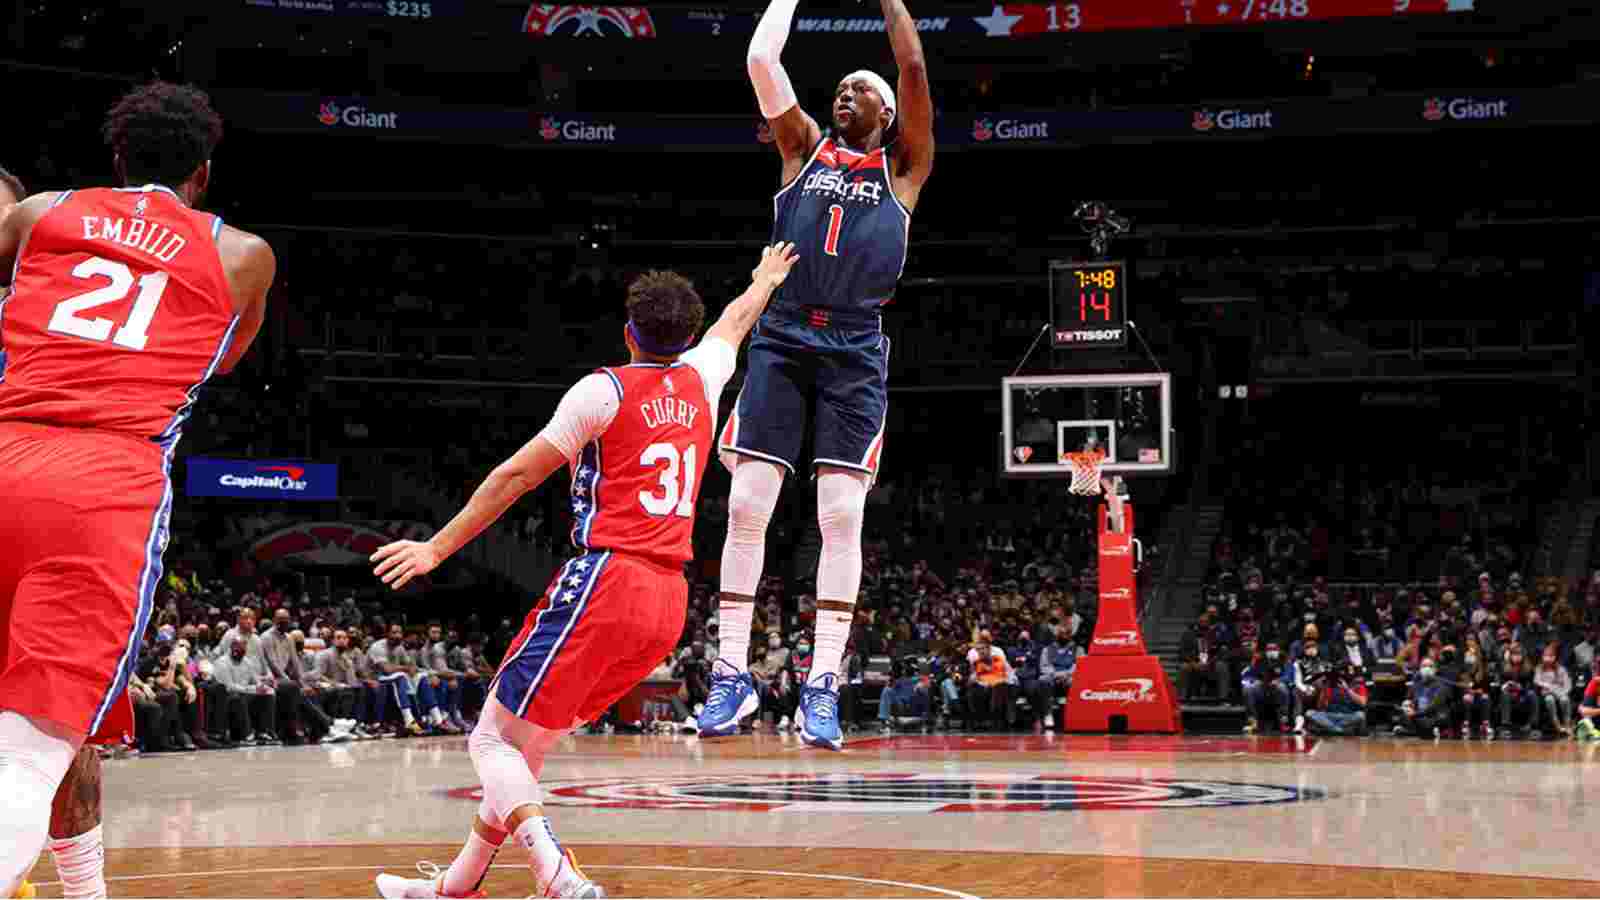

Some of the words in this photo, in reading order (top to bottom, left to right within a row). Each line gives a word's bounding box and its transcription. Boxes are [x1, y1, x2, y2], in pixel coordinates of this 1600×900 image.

[797, 17, 950, 32] WASHINON
[1045, 5, 1081, 30] 13
[342, 107, 397, 129] Giant
[1217, 110, 1272, 130] Giant
[1448, 99, 1507, 120] Giant
[562, 120, 616, 141] Giant
[995, 119, 1048, 139] Giant
[803, 169, 883, 200] district
[80, 215, 188, 263] EMBIID
[824, 204, 844, 257] 1
[1074, 269, 1115, 289] 7:48
[47, 256, 170, 351] 21
[1079, 292, 1110, 321] 14
[1073, 329, 1122, 341] TISSOT
[640, 397, 699, 429] CURRY
[639, 442, 697, 518] 31
